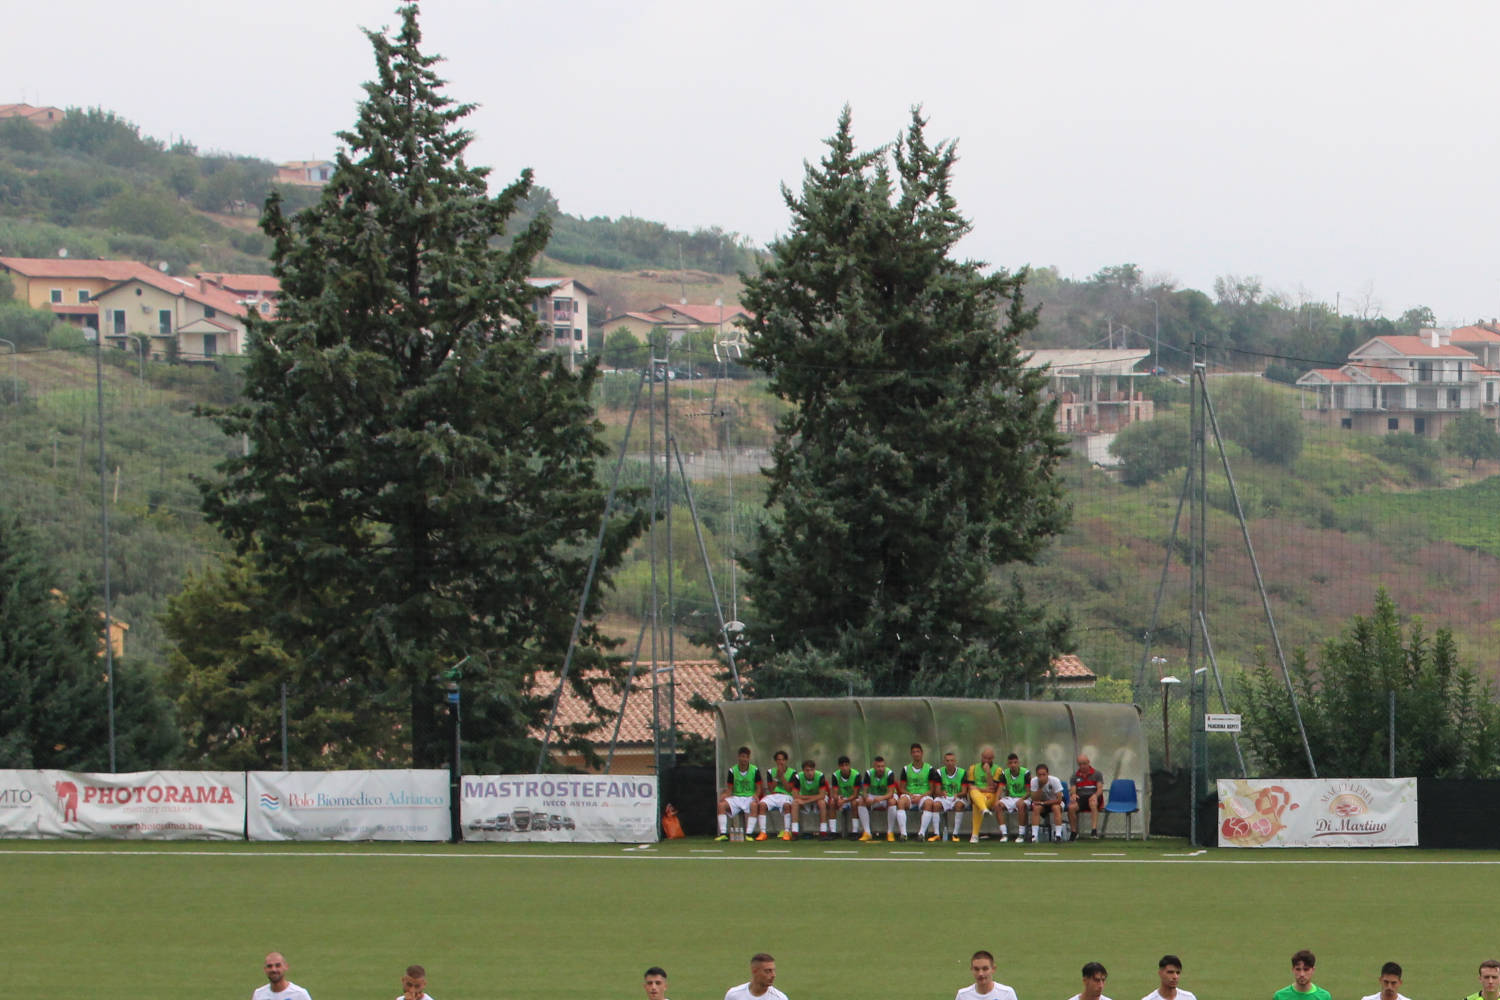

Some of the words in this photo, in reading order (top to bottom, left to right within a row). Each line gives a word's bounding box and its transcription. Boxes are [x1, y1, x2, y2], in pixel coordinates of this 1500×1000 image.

[83, 786, 234, 804] PHOTORAMA
[464, 781, 653, 798] MASTROSTEFANO
[289, 792, 315, 807] Polo
[317, 791, 382, 807] Biomedico
[1315, 818, 1331, 832] Di
[1335, 818, 1387, 832] Martino
